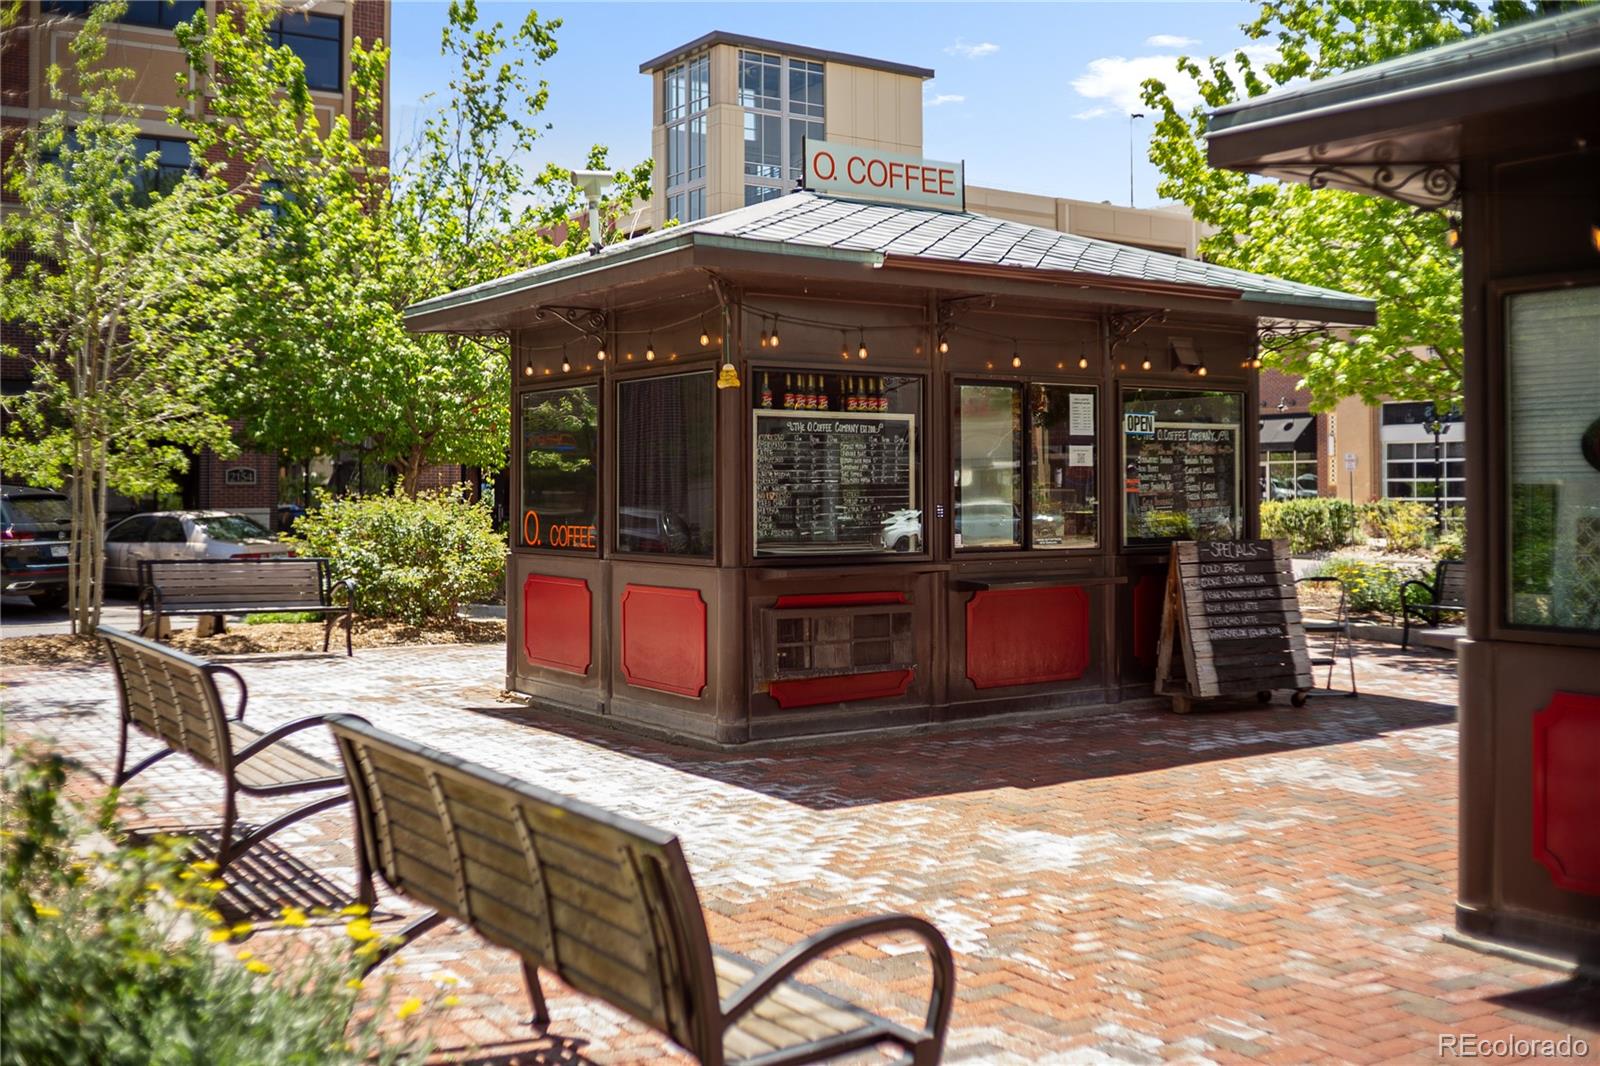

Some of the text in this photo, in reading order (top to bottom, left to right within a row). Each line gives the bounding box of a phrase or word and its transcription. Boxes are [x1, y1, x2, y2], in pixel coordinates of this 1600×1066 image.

[812, 151, 955, 196] O. COFFEE
[1127, 415, 1153, 432] OPEN
[524, 510, 596, 549] O. COFFEE
[1210, 541, 1258, 559] SPECIALS
[1201, 563, 1246, 575] COLD BREW
